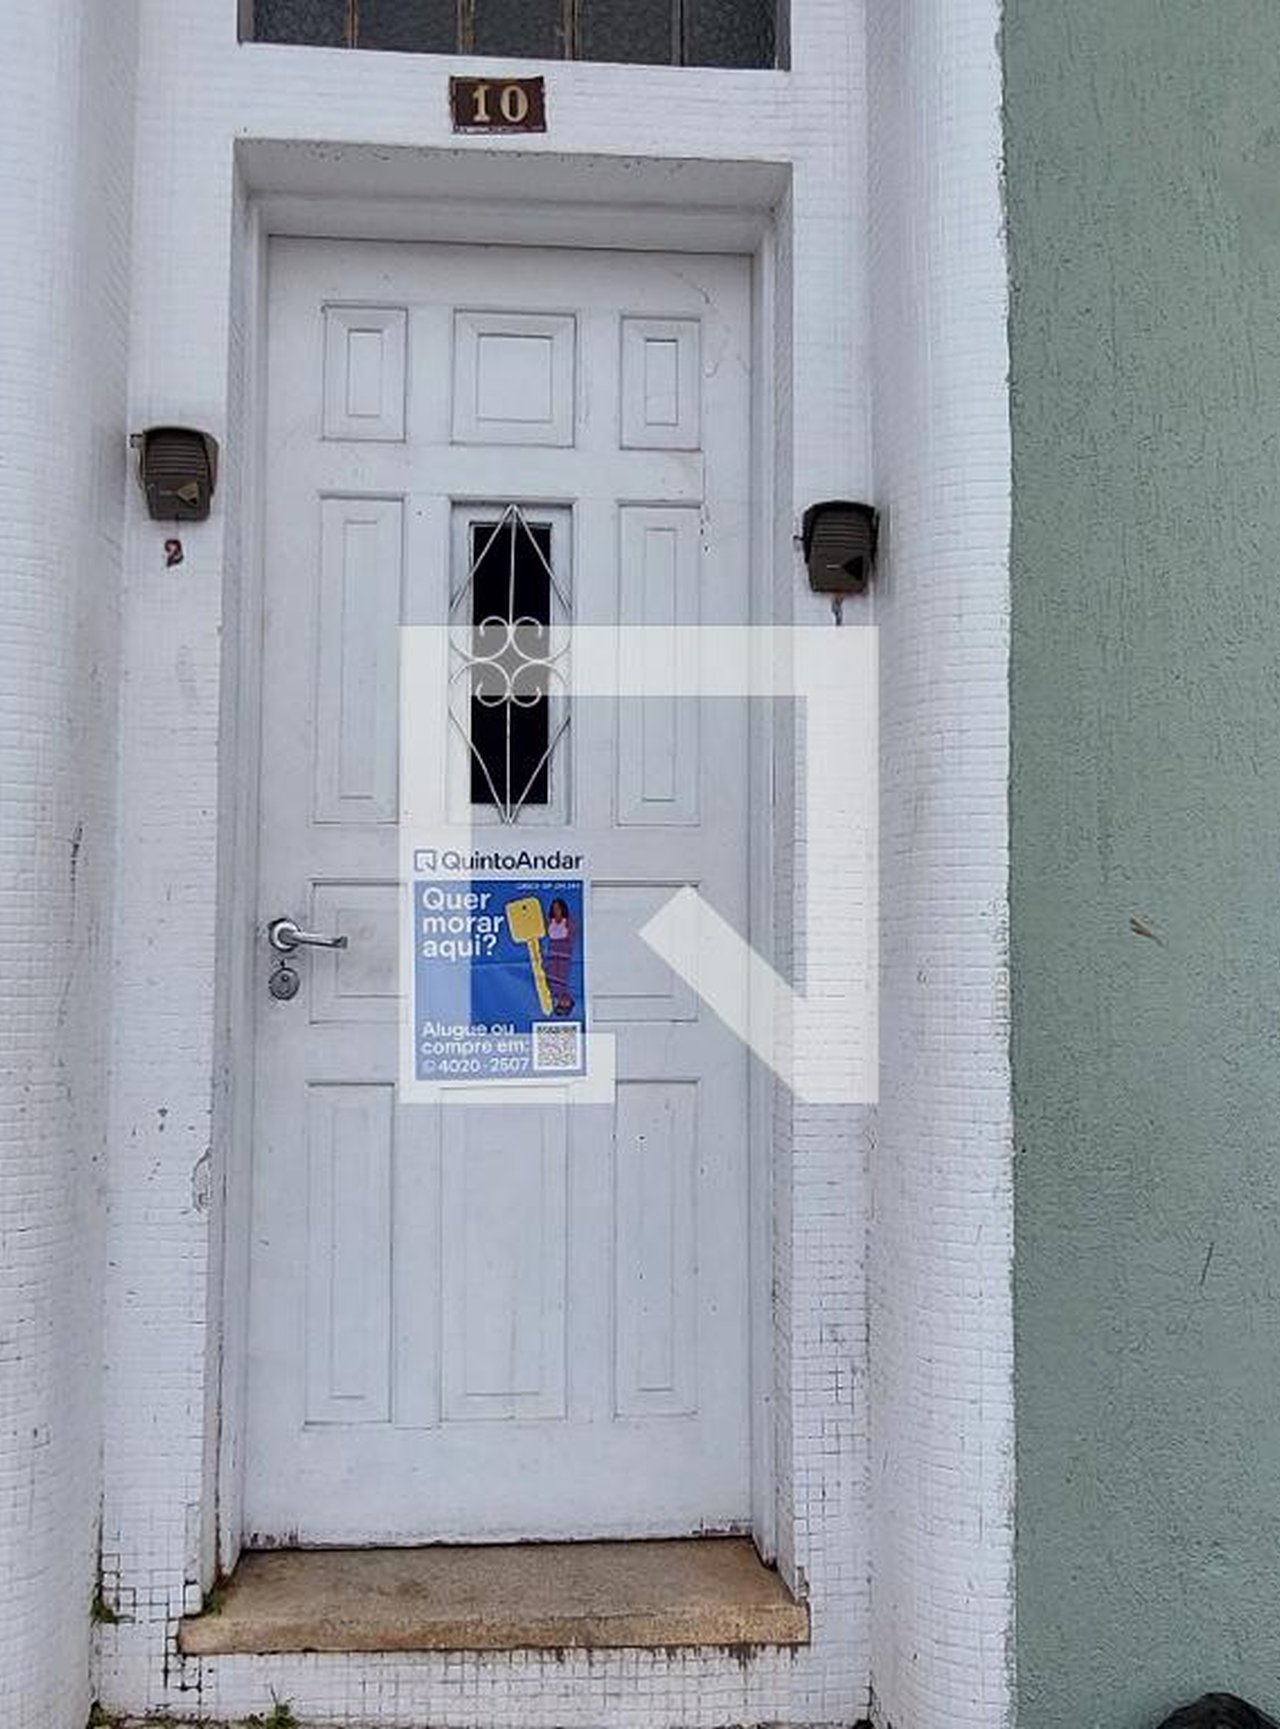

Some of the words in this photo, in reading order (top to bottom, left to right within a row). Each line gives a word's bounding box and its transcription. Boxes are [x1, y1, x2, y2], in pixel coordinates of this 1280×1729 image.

[472, 84, 529, 123] 10
[441, 850, 584, 871] QuintoAndar
[422, 886, 491, 911] Quer
[422, 915, 504, 934] morar
[422, 934, 497, 961] aqui?
[422, 1021, 487, 1040] Alugue
[491, 1023, 515, 1036] ou
[422, 1040, 493, 1059] compre
[497, 1039, 529, 1054] em:
